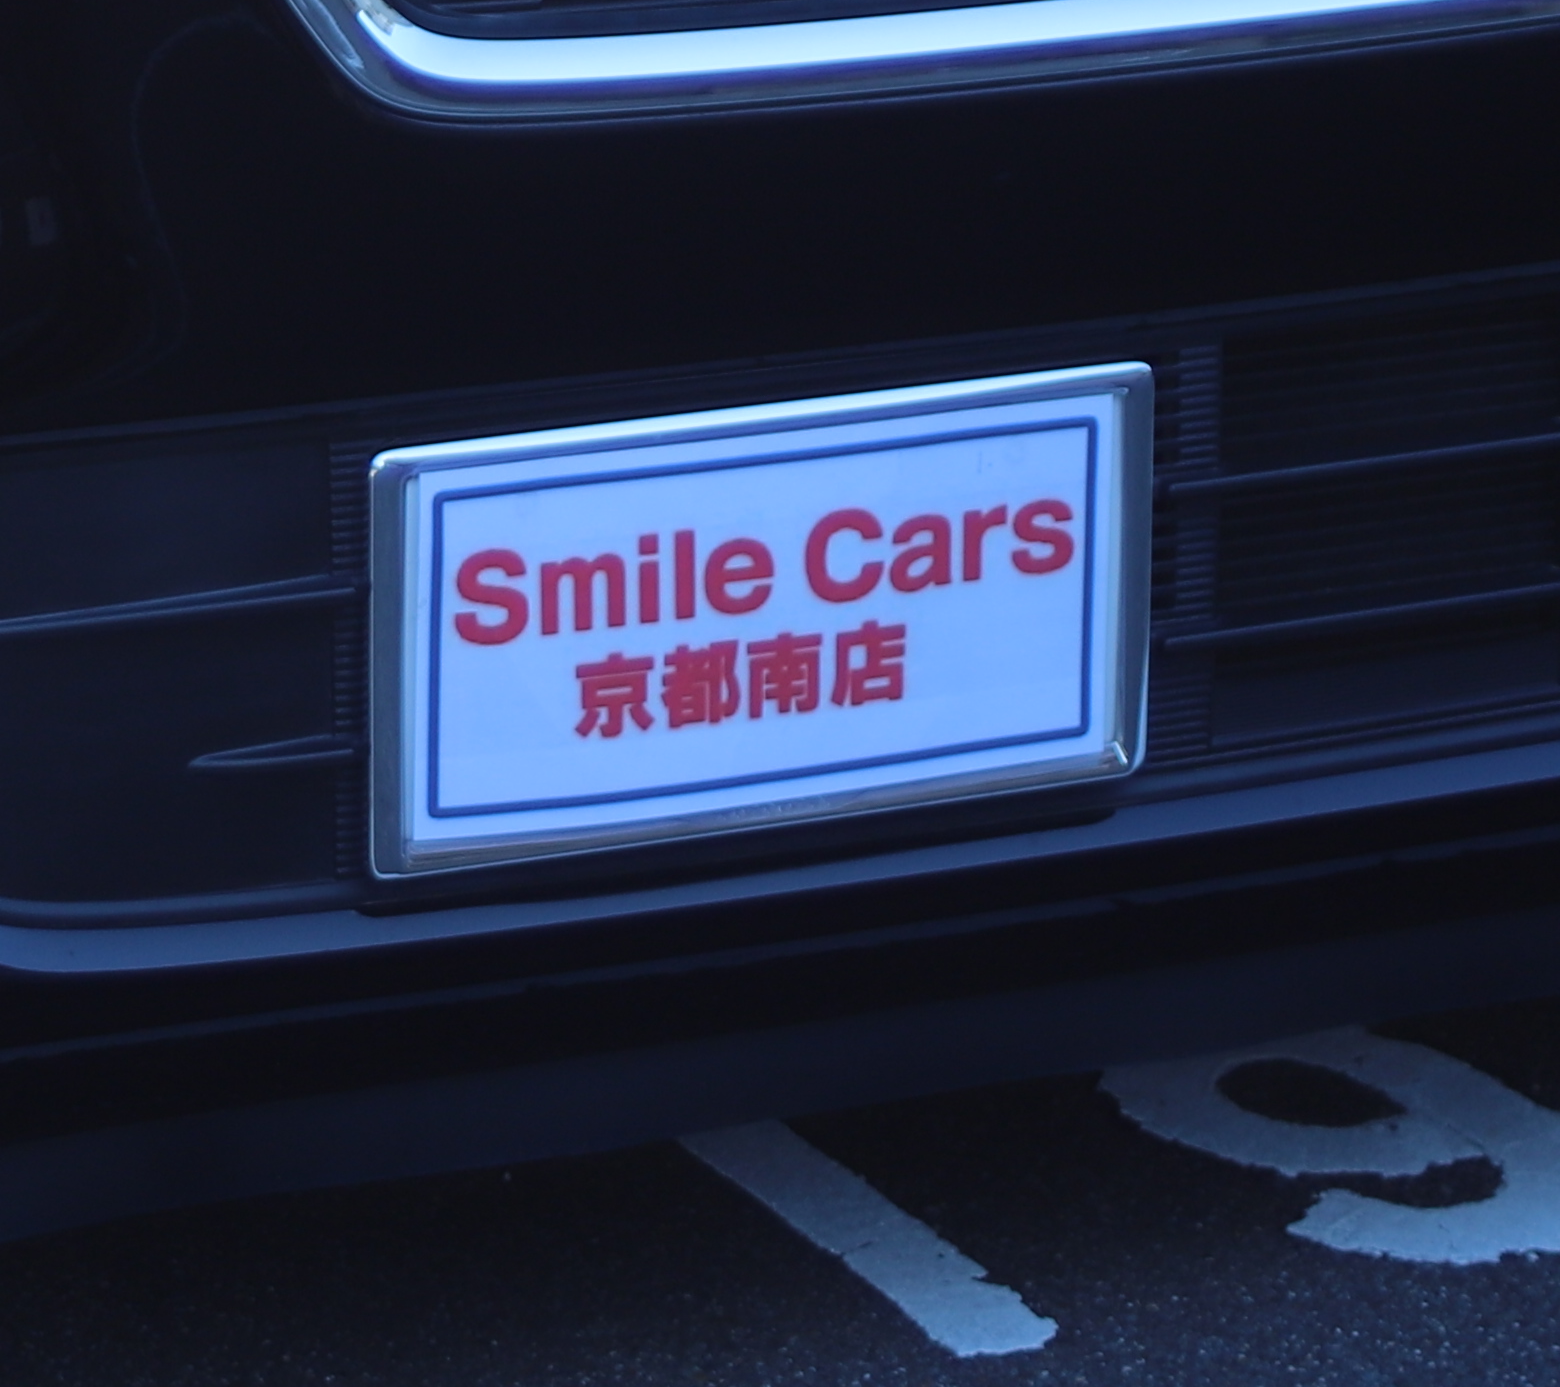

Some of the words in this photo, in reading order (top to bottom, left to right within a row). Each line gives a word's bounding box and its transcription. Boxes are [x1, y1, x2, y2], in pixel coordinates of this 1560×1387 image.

[453, 529, 774, 646] Smile
[804, 497, 1075, 604] Cars
[573, 620, 908, 739] 京都南店
